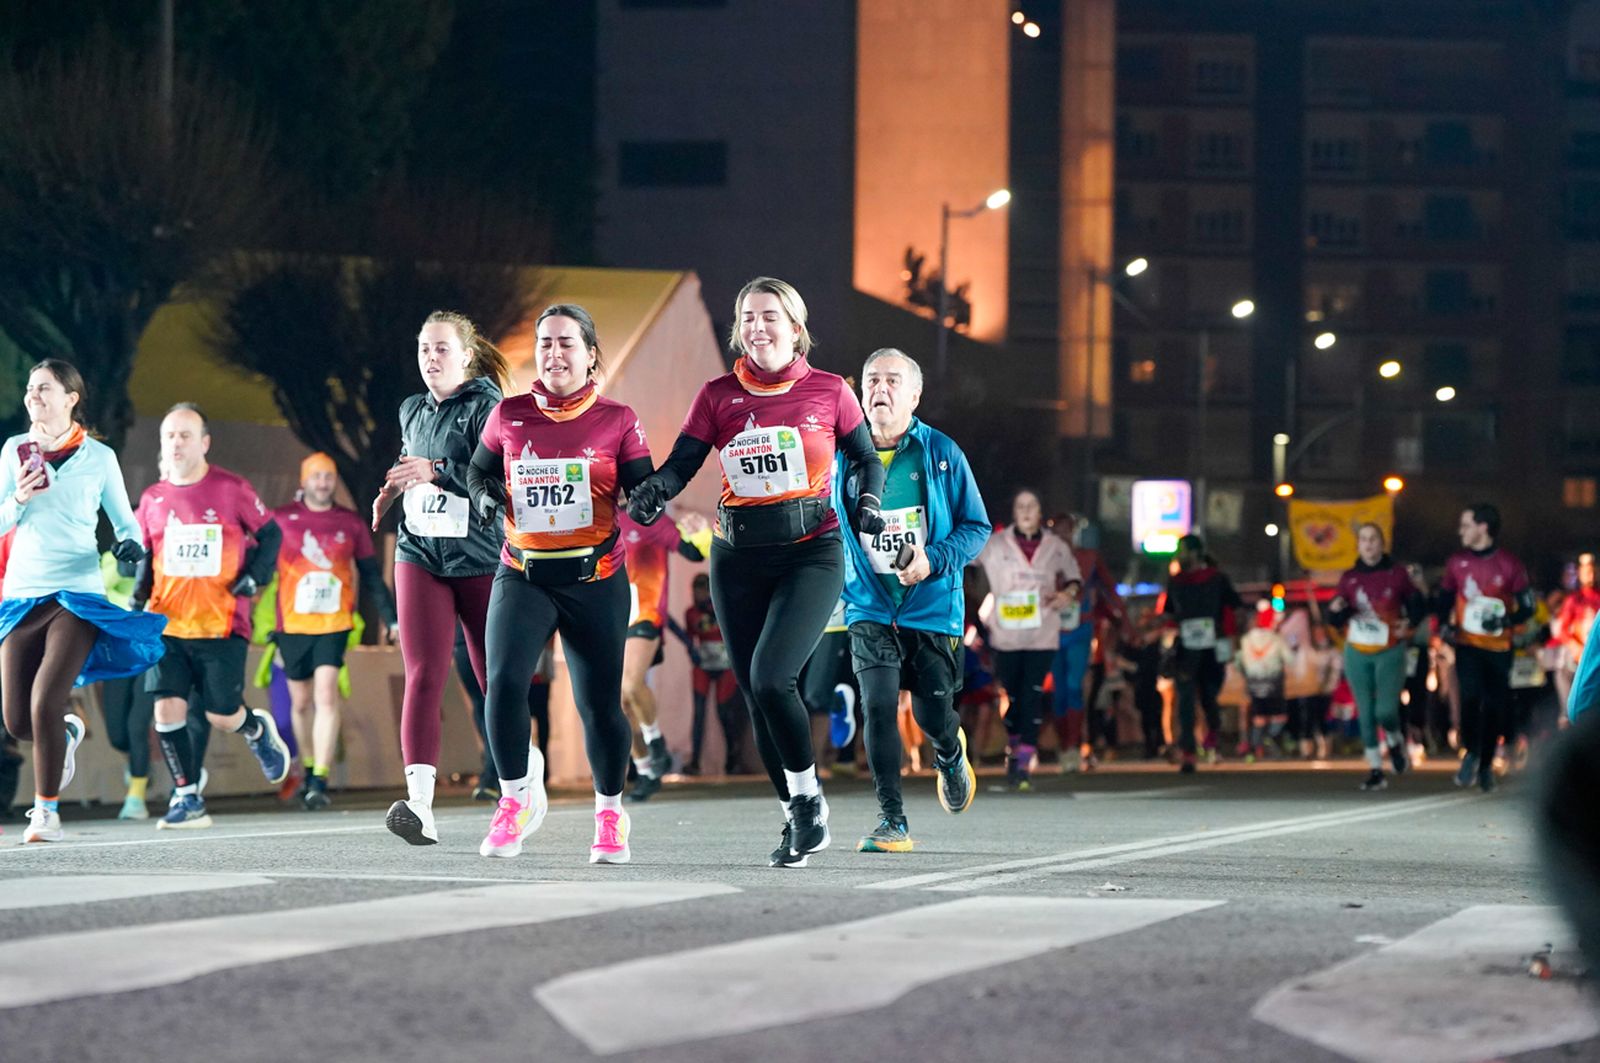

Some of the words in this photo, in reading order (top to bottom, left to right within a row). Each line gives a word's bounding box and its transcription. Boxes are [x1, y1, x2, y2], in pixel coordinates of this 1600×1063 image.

[737, 438, 759, 447] NOCHE
[729, 449, 744, 458] SAN
[740, 452, 788, 475] 5761
[526, 467, 548, 475] NOCHE
[518, 477, 533, 485] SAN
[526, 484, 575, 507] 5762
[422, 494, 447, 513] 122
[871, 532, 916, 552] 4559
[177, 544, 209, 558] 4724
